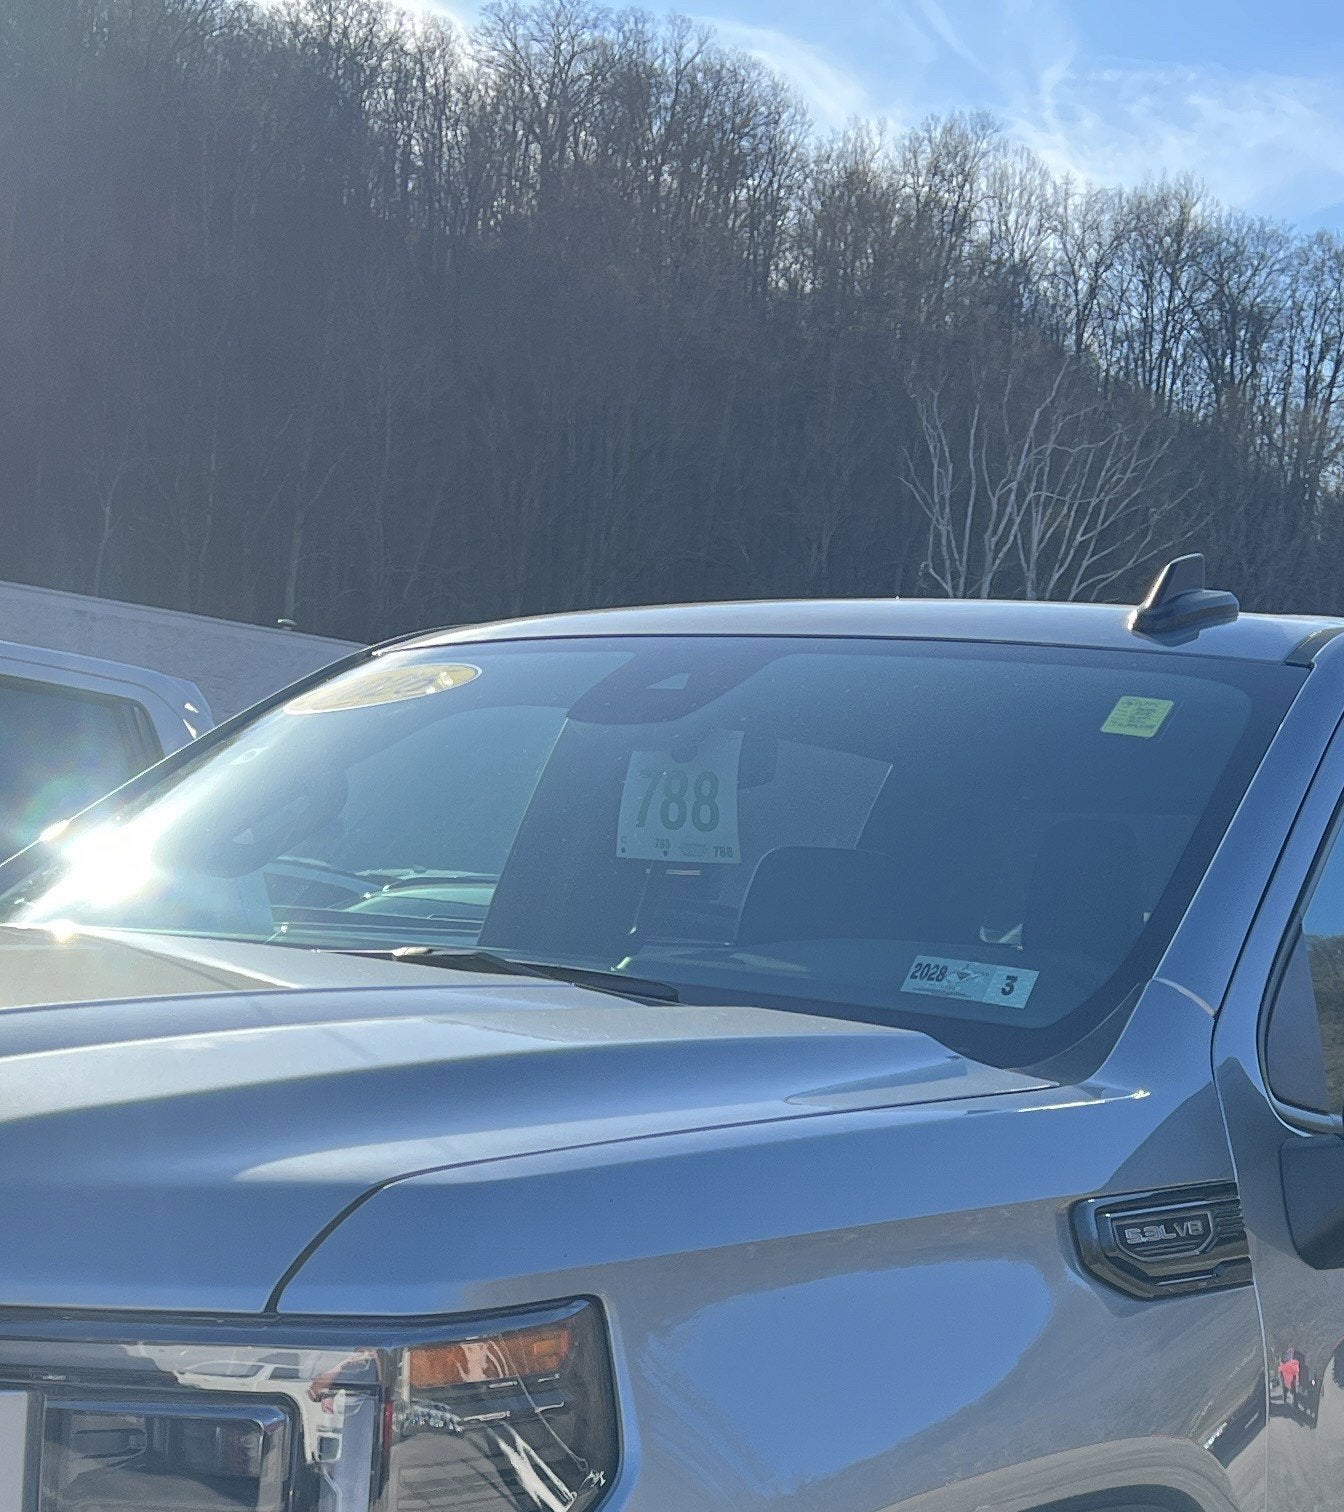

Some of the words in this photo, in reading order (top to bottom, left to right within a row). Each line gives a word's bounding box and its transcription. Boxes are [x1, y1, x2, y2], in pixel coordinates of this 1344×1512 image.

[635, 769, 720, 833] 788
[910, 963, 948, 982] 2028
[1001, 975, 1018, 995] 3
